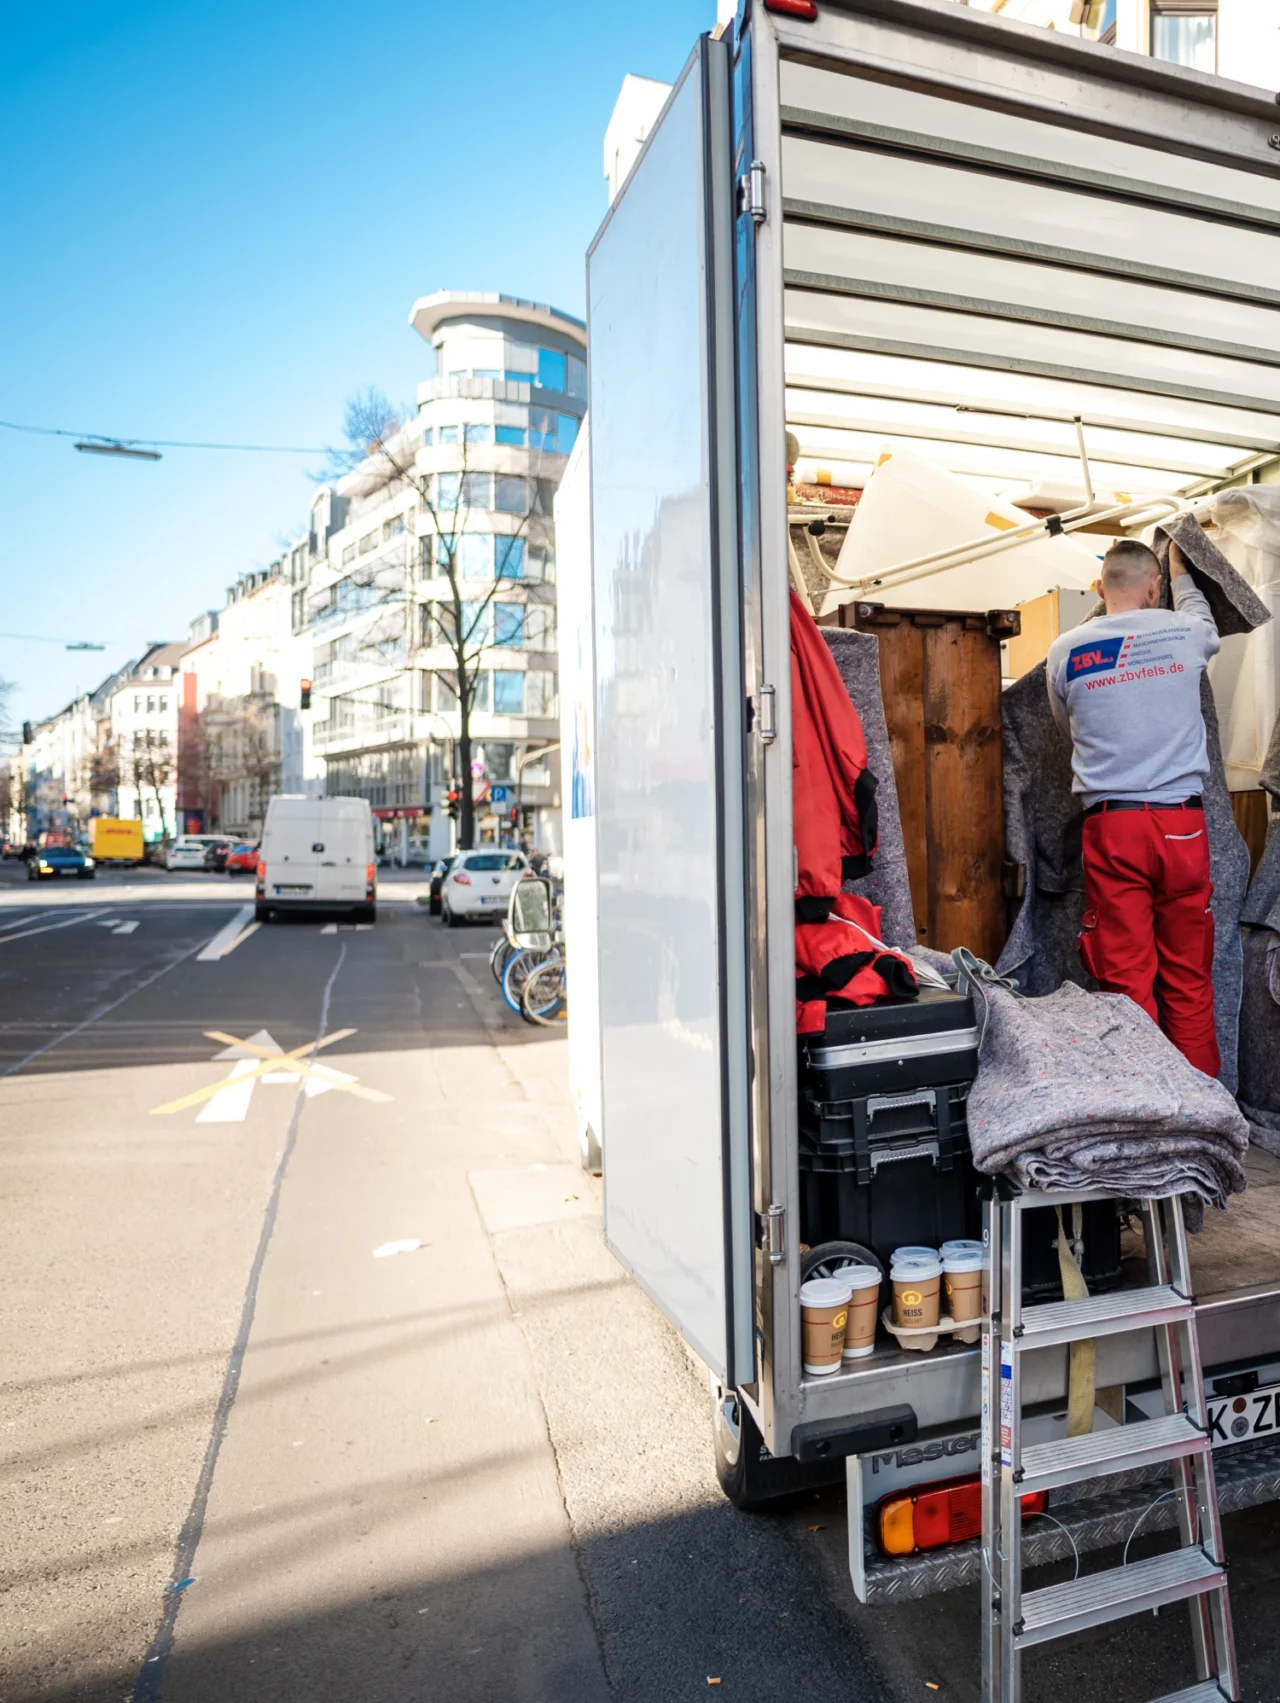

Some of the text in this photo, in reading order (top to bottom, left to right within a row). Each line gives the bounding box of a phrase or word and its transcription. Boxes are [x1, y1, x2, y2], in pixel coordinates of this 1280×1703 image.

[1071, 650, 1102, 671] ZBV
[1085, 662, 1185, 690] www.zbvfels.de
[903, 1308, 923, 1317] HEISS
[1207, 1404, 1228, 1442] K
[872, 1432, 982, 1475] Master
